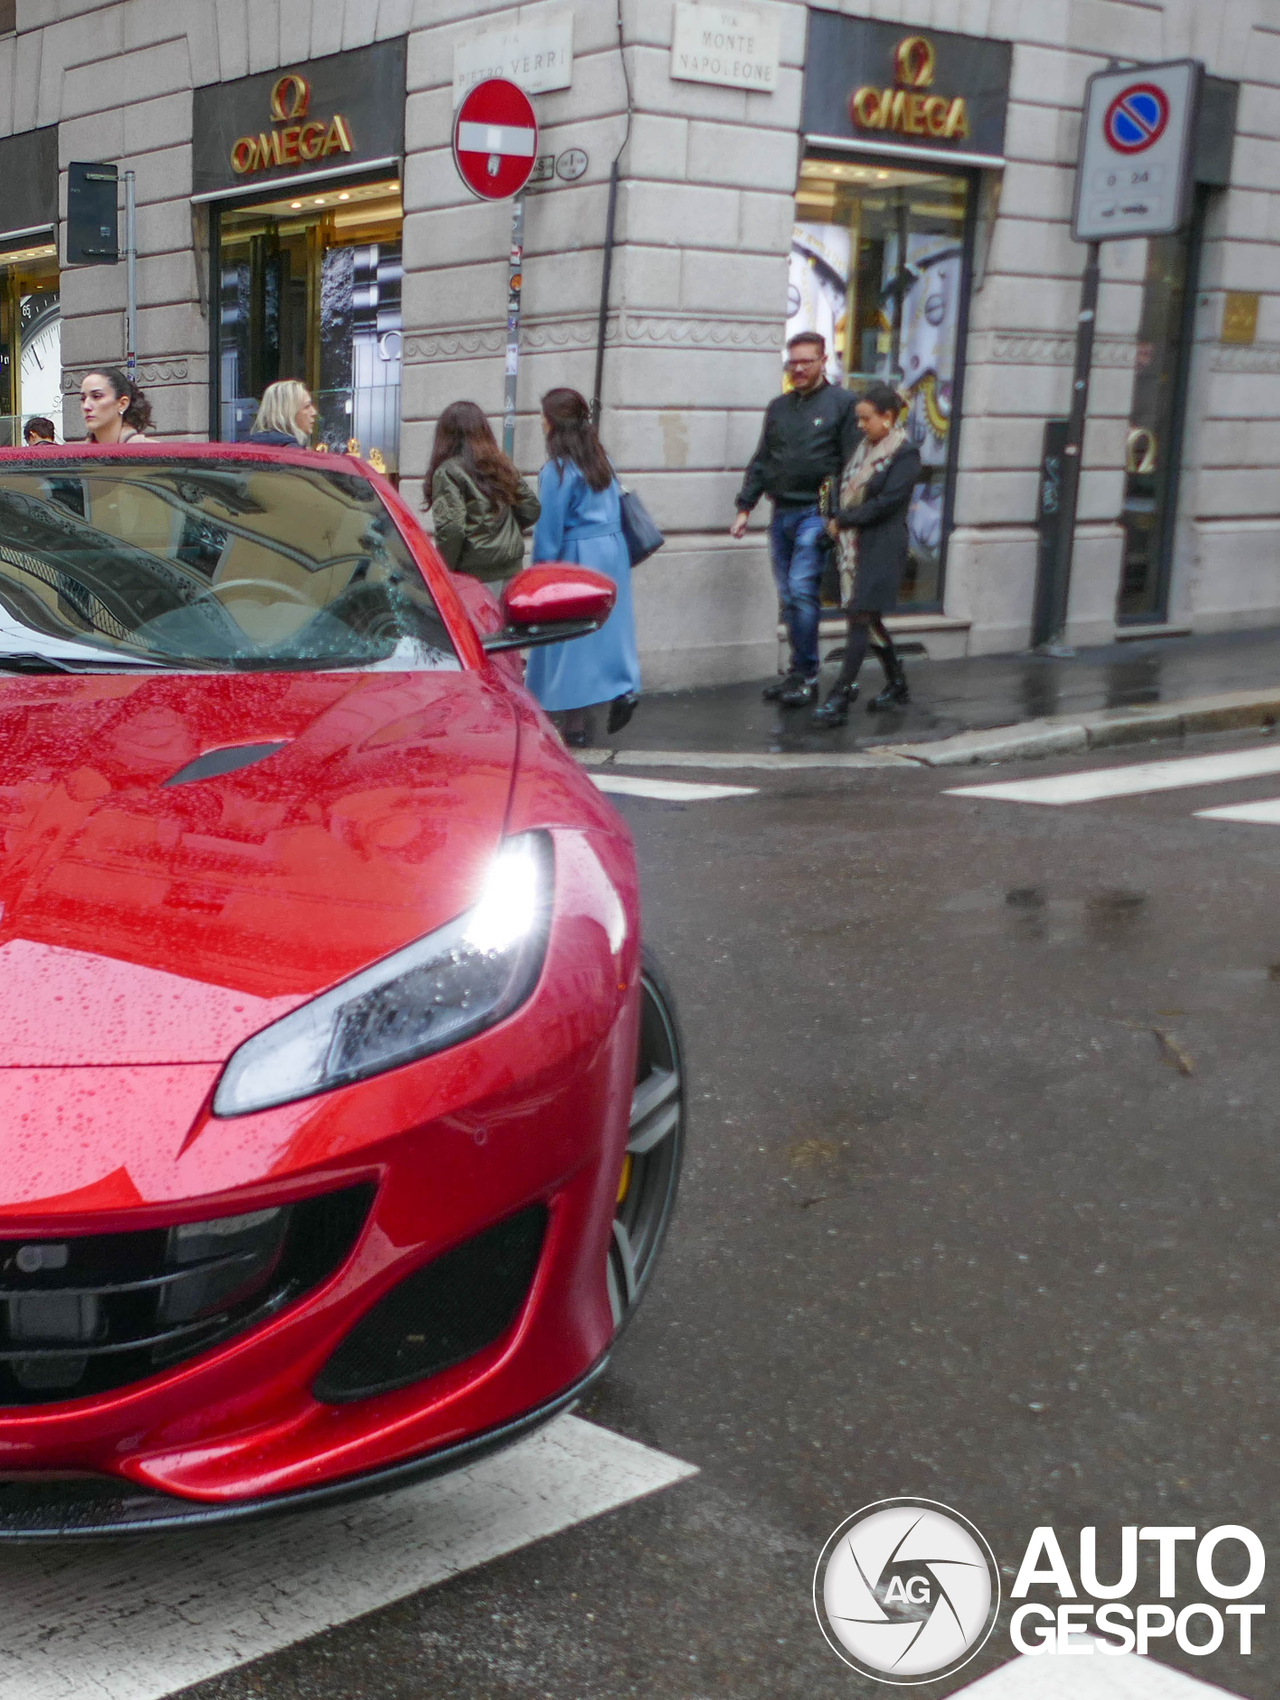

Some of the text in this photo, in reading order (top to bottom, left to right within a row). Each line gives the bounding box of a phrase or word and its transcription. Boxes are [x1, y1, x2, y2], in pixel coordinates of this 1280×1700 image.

[721, 13, 738, 27] VIA
[702, 31, 754, 54] MONTE
[511, 49, 565, 75] VERRI
[680, 54, 772, 82] NAPOLEONE
[852, 86, 970, 138] OMEGA
[230, 114, 353, 174] OMEGA
[22, 304, 31, 317] 65
